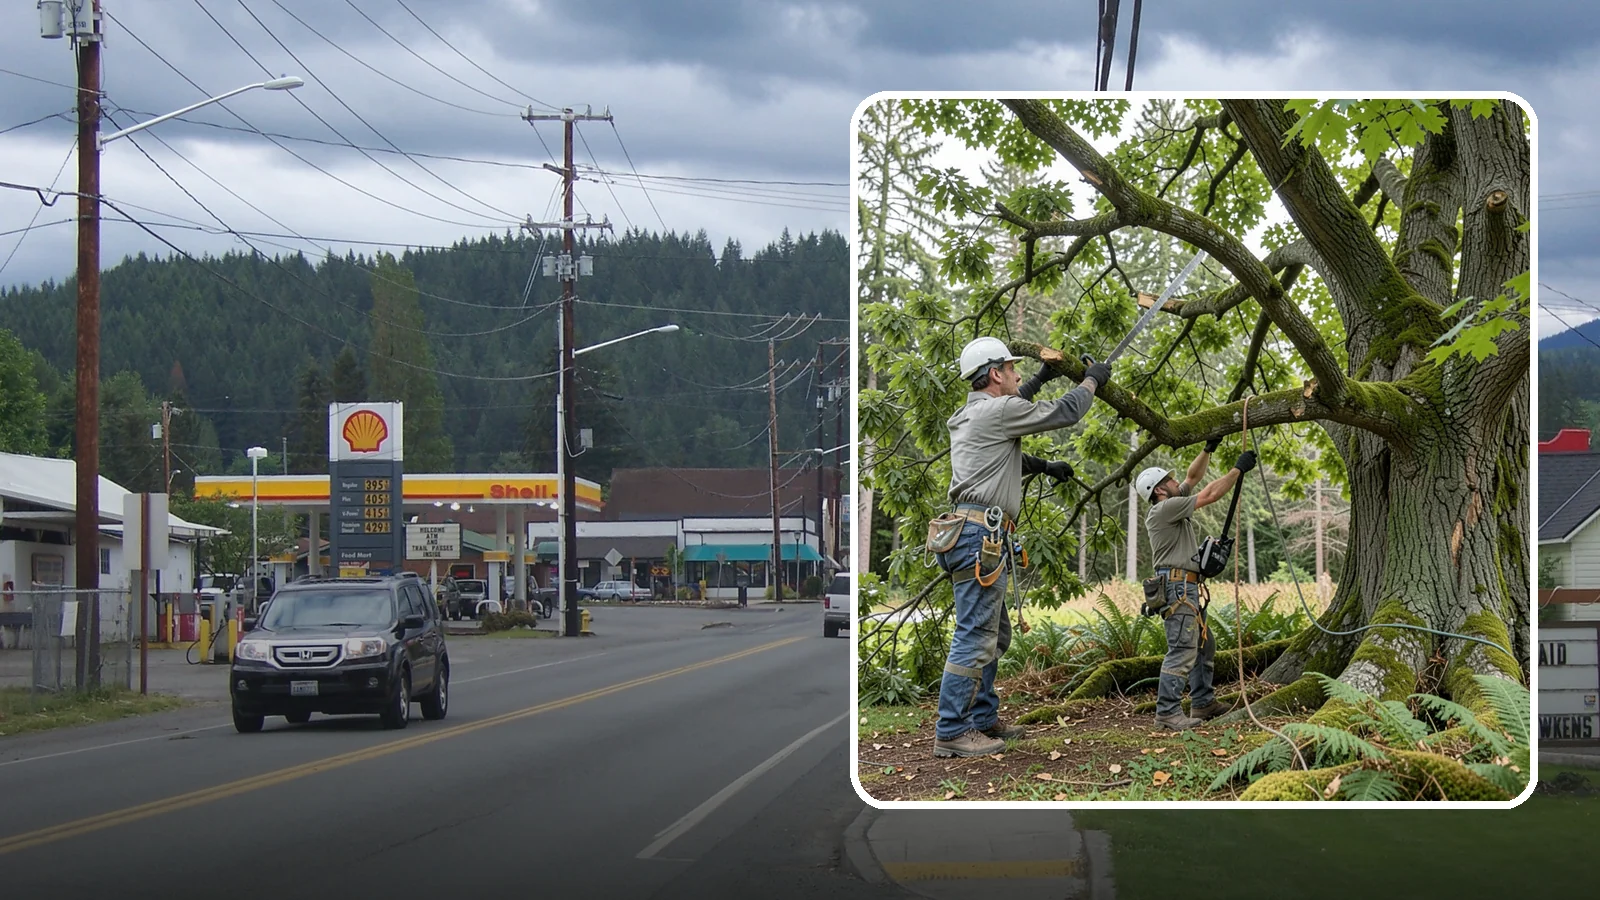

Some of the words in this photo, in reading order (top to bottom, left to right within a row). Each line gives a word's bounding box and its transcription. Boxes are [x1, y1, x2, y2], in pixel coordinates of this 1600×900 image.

[365, 480, 383, 490] 395
[490, 484, 547, 499] Shell
[365, 494, 383, 504] 405
[365, 508, 383, 518] 415
[365, 522, 383, 532] 429
[1538, 642, 1566, 665] AID
